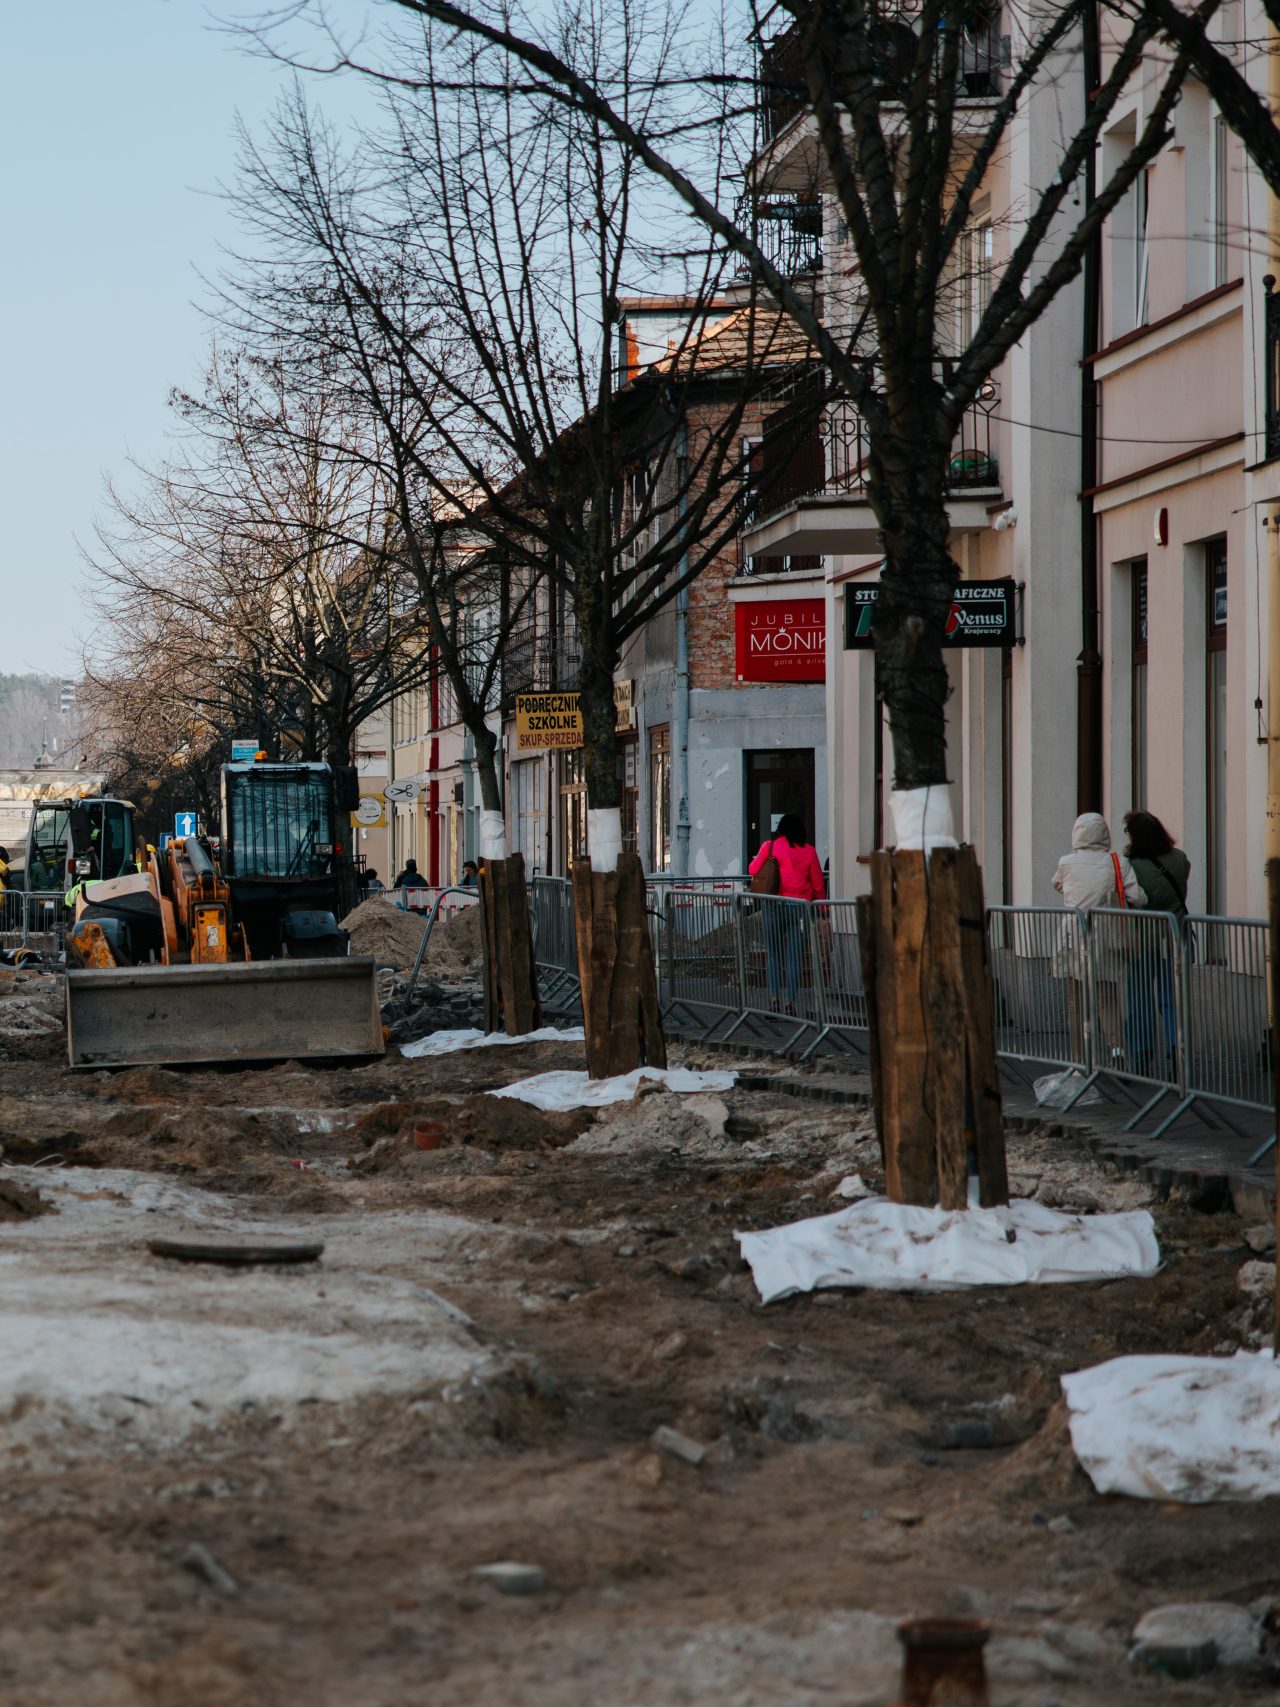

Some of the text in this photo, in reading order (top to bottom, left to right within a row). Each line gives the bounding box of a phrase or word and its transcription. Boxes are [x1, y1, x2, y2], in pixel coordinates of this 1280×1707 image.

[954, 609, 1003, 625] Venus
[774, 659, 793, 667] gold
[528, 715, 577, 730] SZKOLNE
[520, 731, 584, 747] SKUP-SPRZEDA
